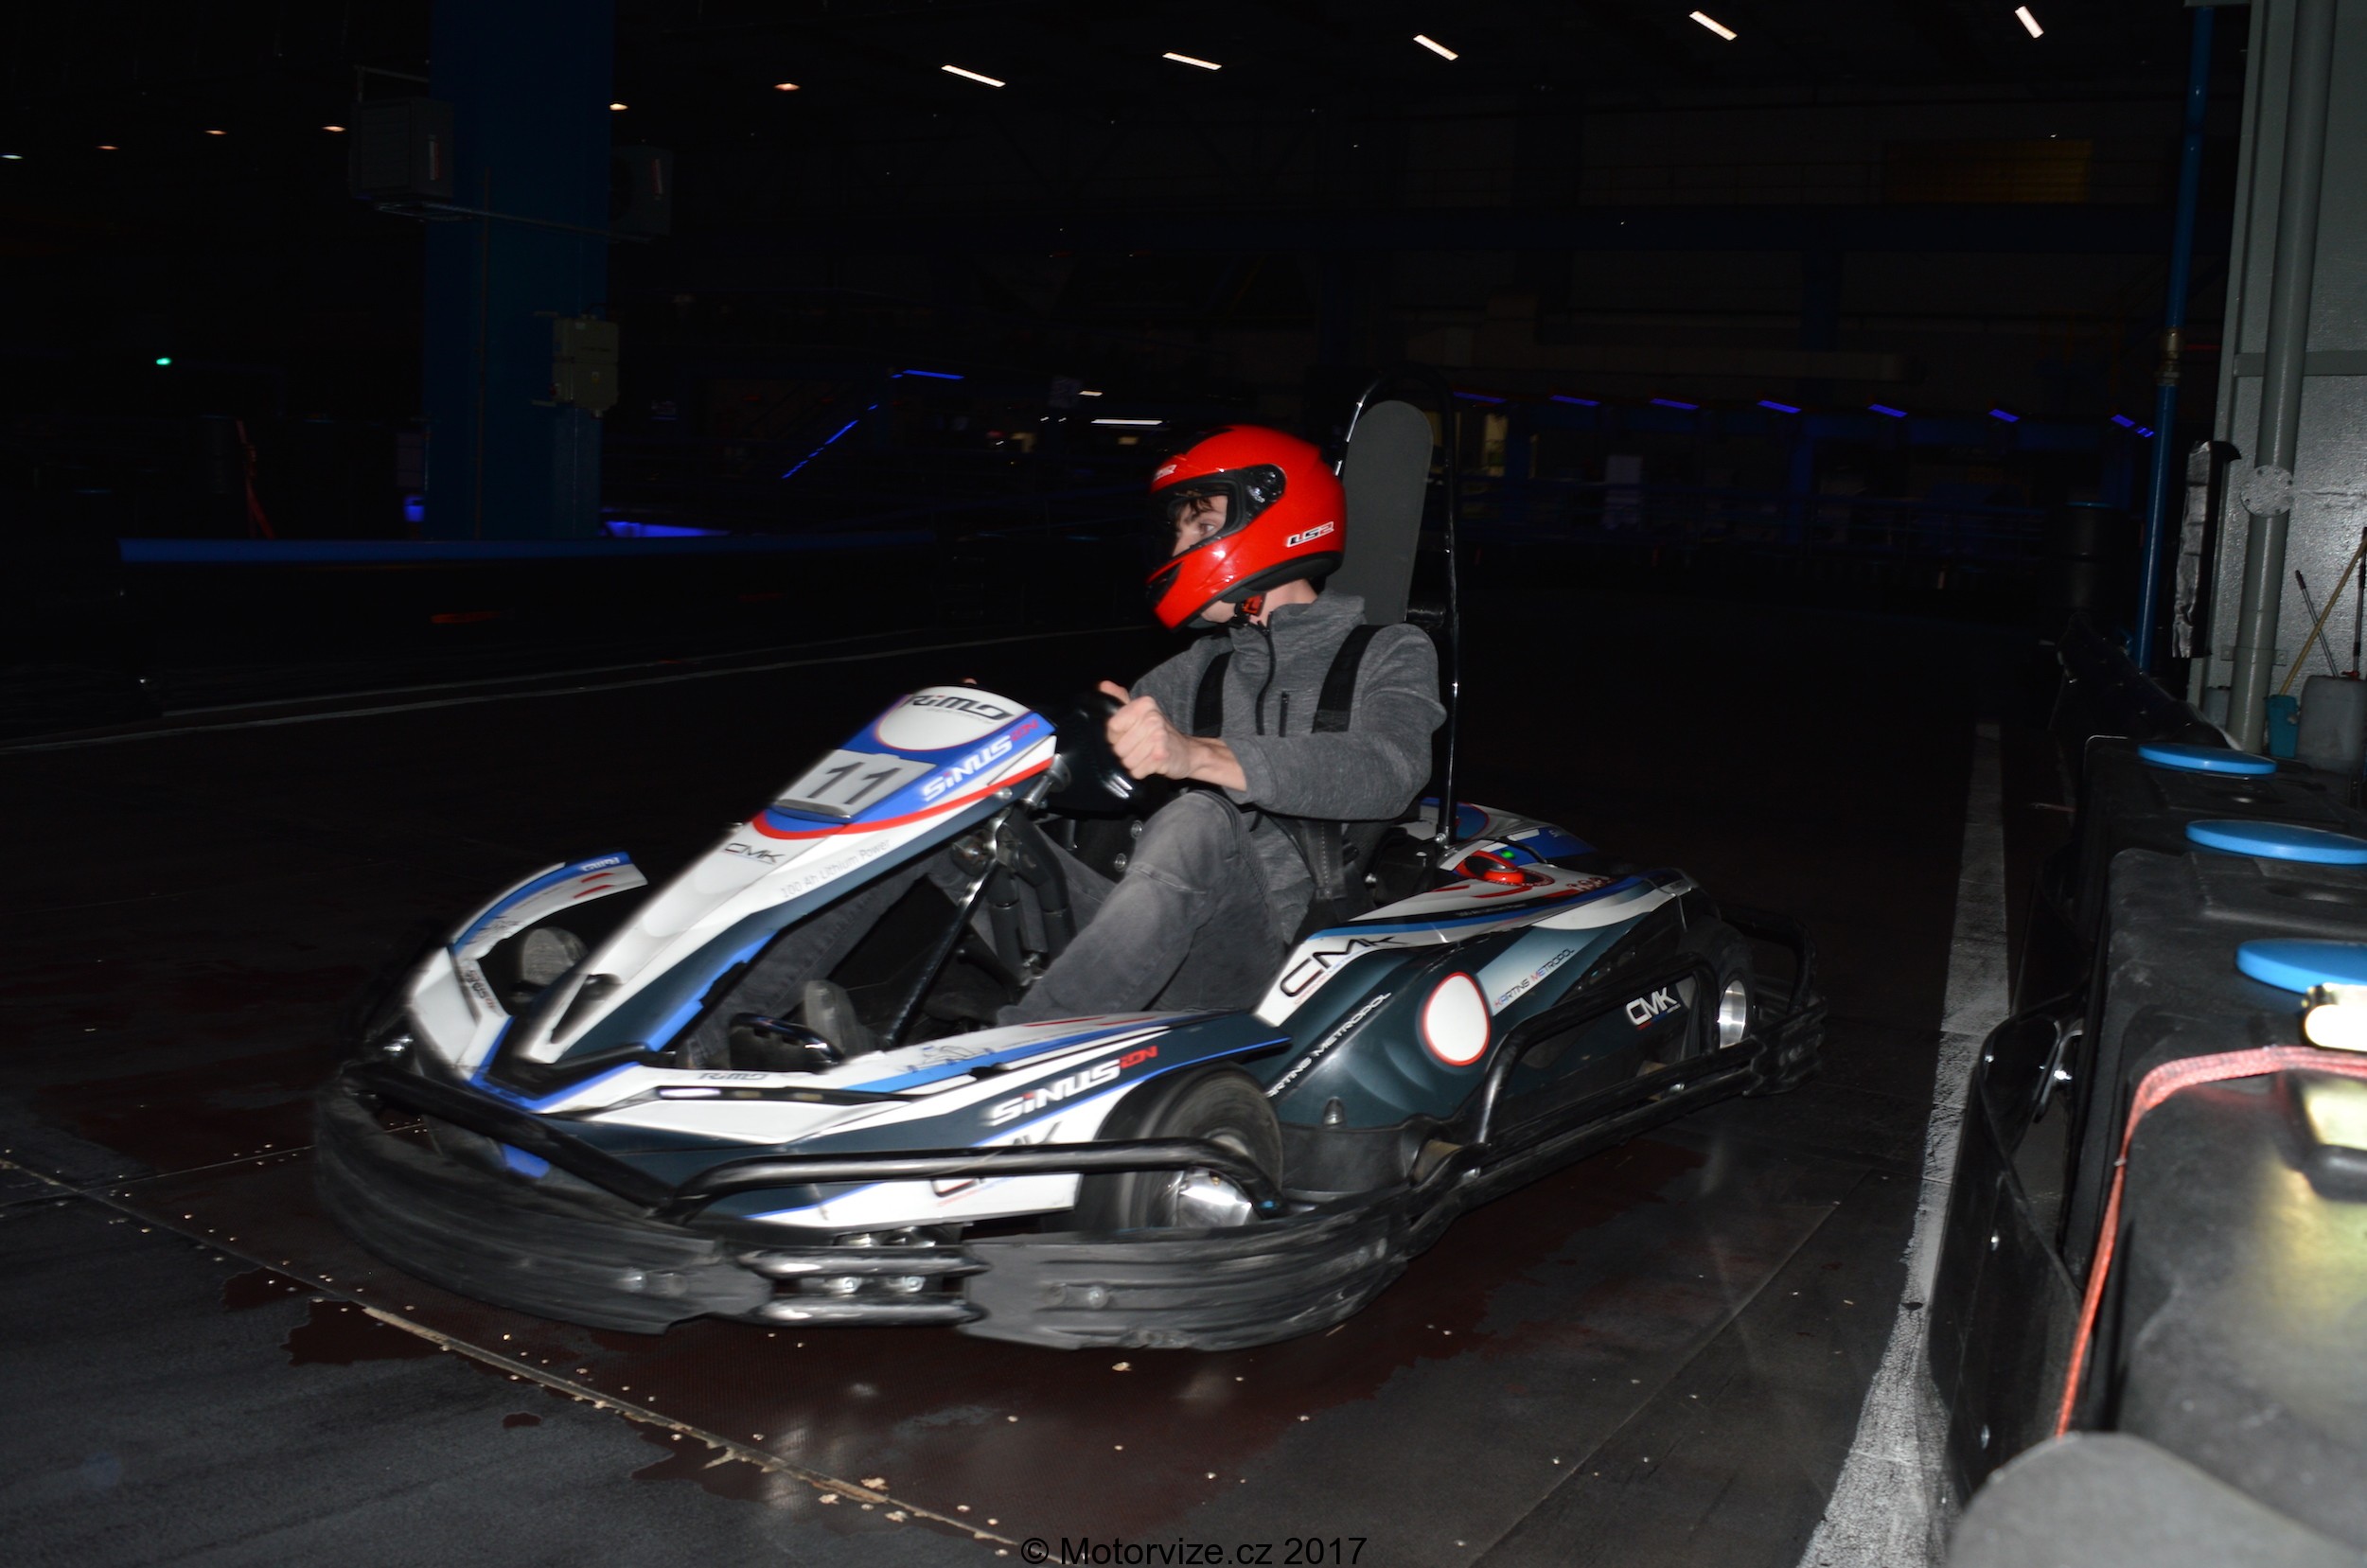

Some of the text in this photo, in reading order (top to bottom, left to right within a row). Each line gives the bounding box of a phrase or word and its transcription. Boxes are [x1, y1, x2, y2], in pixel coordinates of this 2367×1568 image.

[1285, 520, 1335, 548] LS2
[806, 761, 903, 805] 11
[725, 842, 786, 863] CMK
[781, 881, 804, 898] 100
[820, 855, 859, 880] Lithium
[859, 839, 891, 860] Power
[1281, 934, 1409, 997] CMK
[1530, 948, 1575, 982] METROPOL
[1625, 987, 1678, 1026] CMK
[1265, 992, 1393, 1099] ARTING METROPOL
